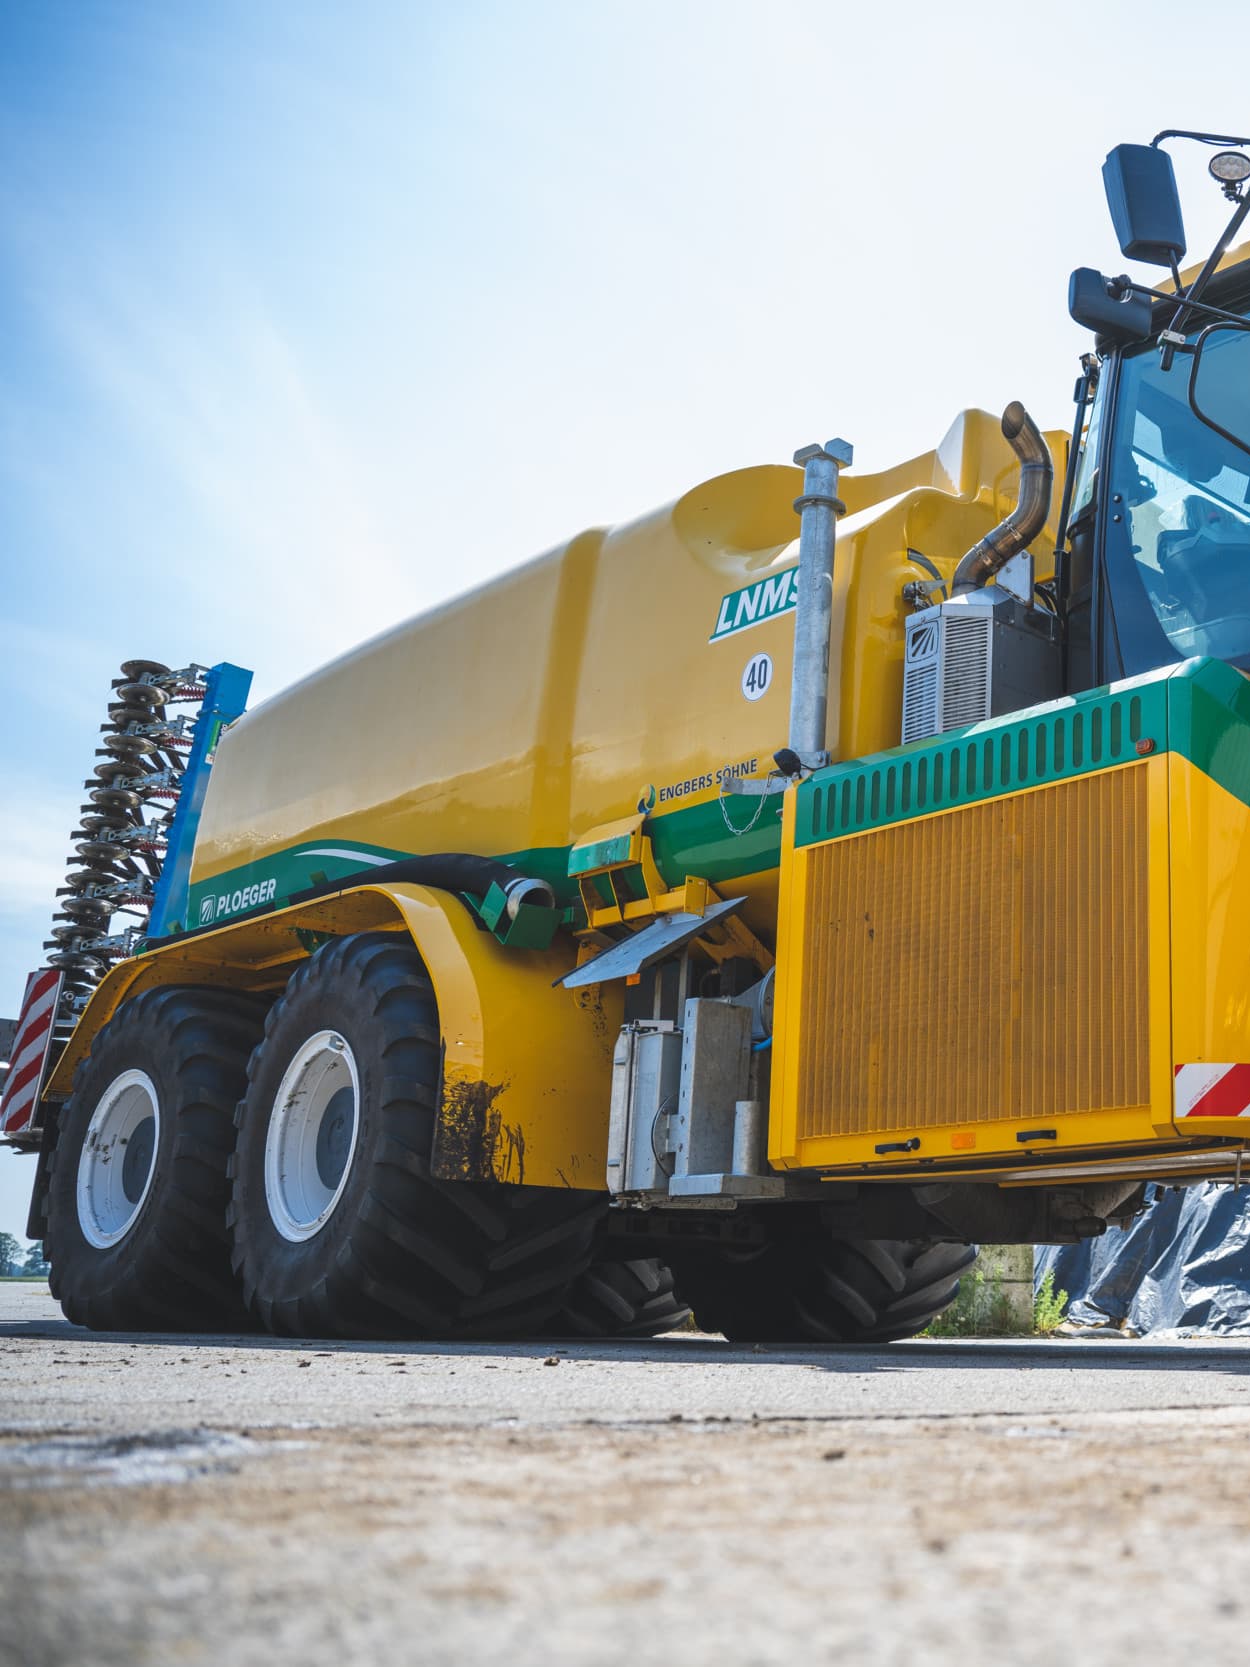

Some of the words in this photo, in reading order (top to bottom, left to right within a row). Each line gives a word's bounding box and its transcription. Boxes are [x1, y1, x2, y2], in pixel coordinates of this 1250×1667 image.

[746, 659, 768, 692] 40
[659, 773, 713, 802] ENGBERS
[716, 759, 757, 784] SÖHNE
[216, 878, 277, 917] PLOEGER
